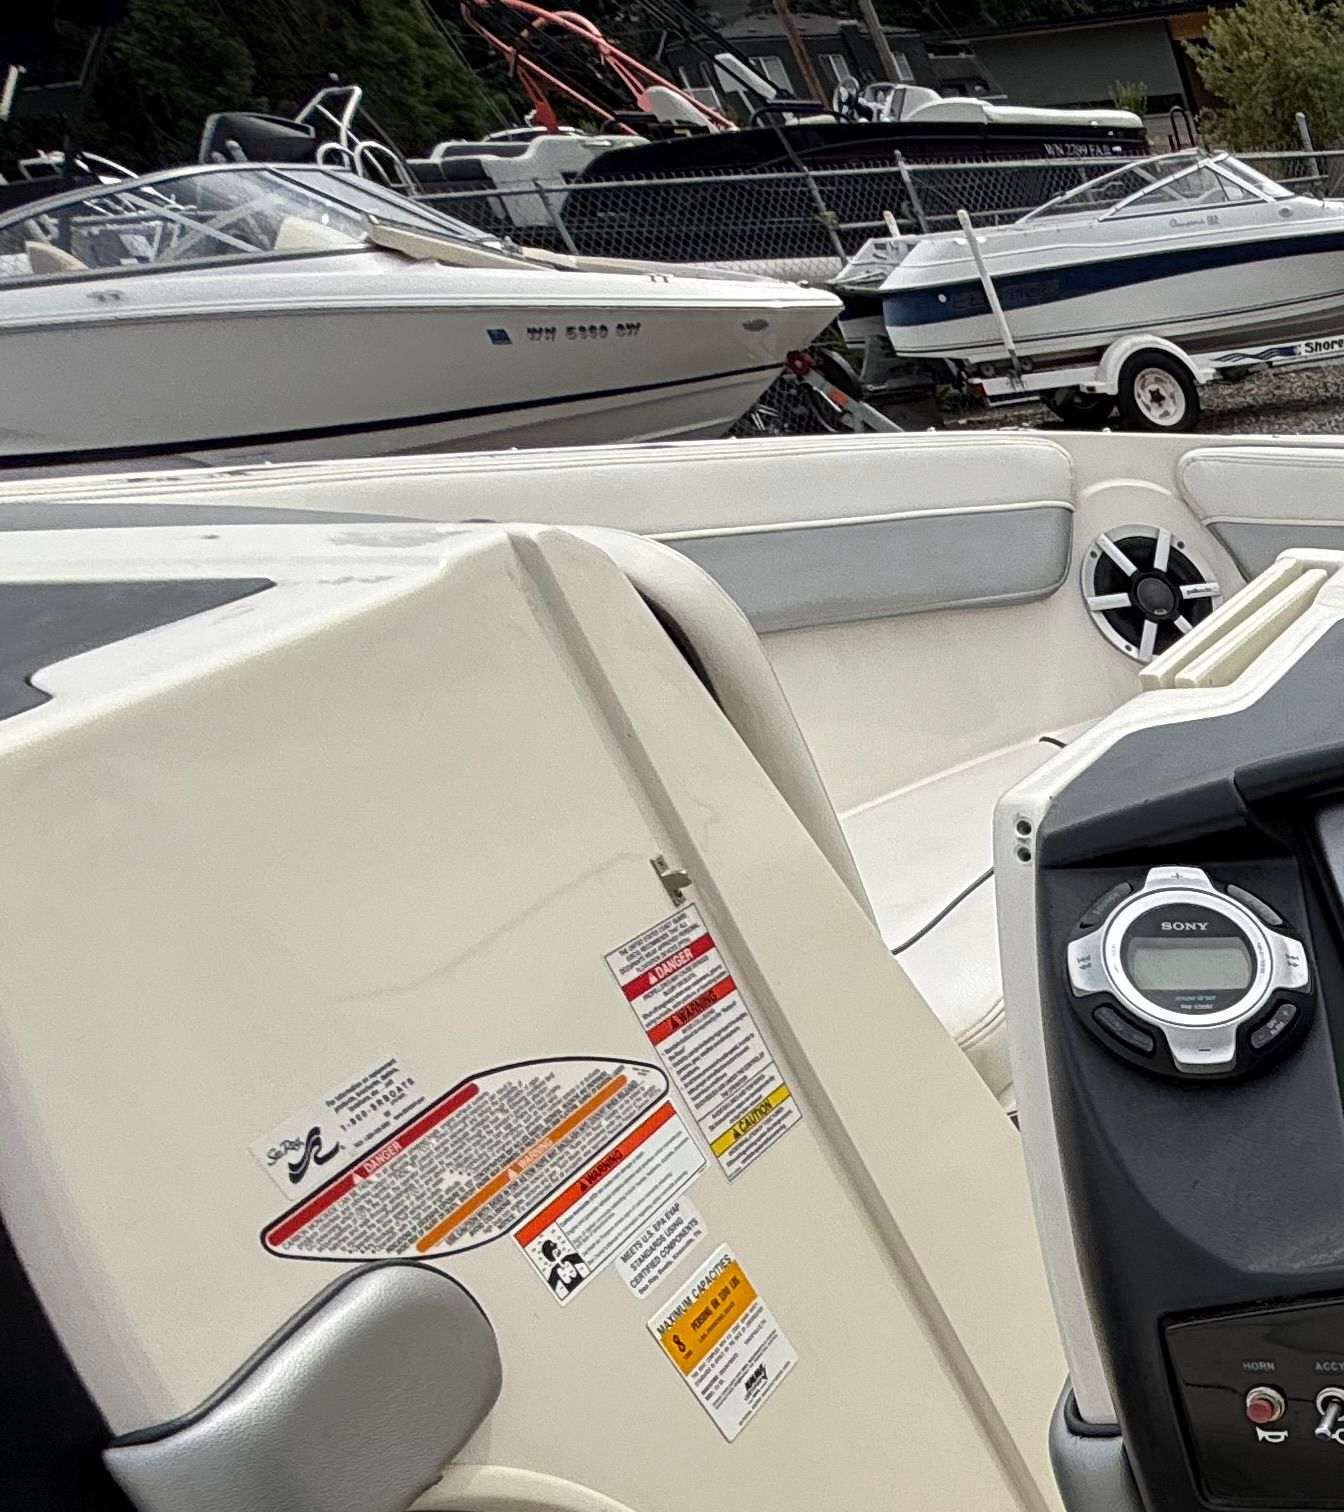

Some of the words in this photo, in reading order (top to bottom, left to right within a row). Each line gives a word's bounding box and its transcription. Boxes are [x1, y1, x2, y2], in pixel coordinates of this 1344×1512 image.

[1161, 921, 1209, 931] SONY
[655, 947, 694, 982] DANGER
[678, 989, 718, 1027] WARNING
[739, 1099, 773, 1133] CAUTION
[363, 1140, 401, 1173] DANGER
[517, 1138, 553, 1170] WARNING
[584, 1149, 624, 1188] WARNING
[620, 1239, 643, 1264] MEETS
[652, 1214, 668, 1235] EPA
[665, 1202, 681, 1222] EVAP
[630, 1233, 666, 1271] STANDARDS
[663, 1216, 684, 1240] USING
[630, 1257, 662, 1289] CERTIFIED
[660, 1218, 699, 1261] COMPONENTS
[656, 1296, 693, 1337] MAXIMUM
[692, 1254, 732, 1300] CAPACITIES
[672, 1334, 687, 1353] 8
[690, 1307, 713, 1331] PERSONS
[1243, 1361, 1276, 1371] HORN
